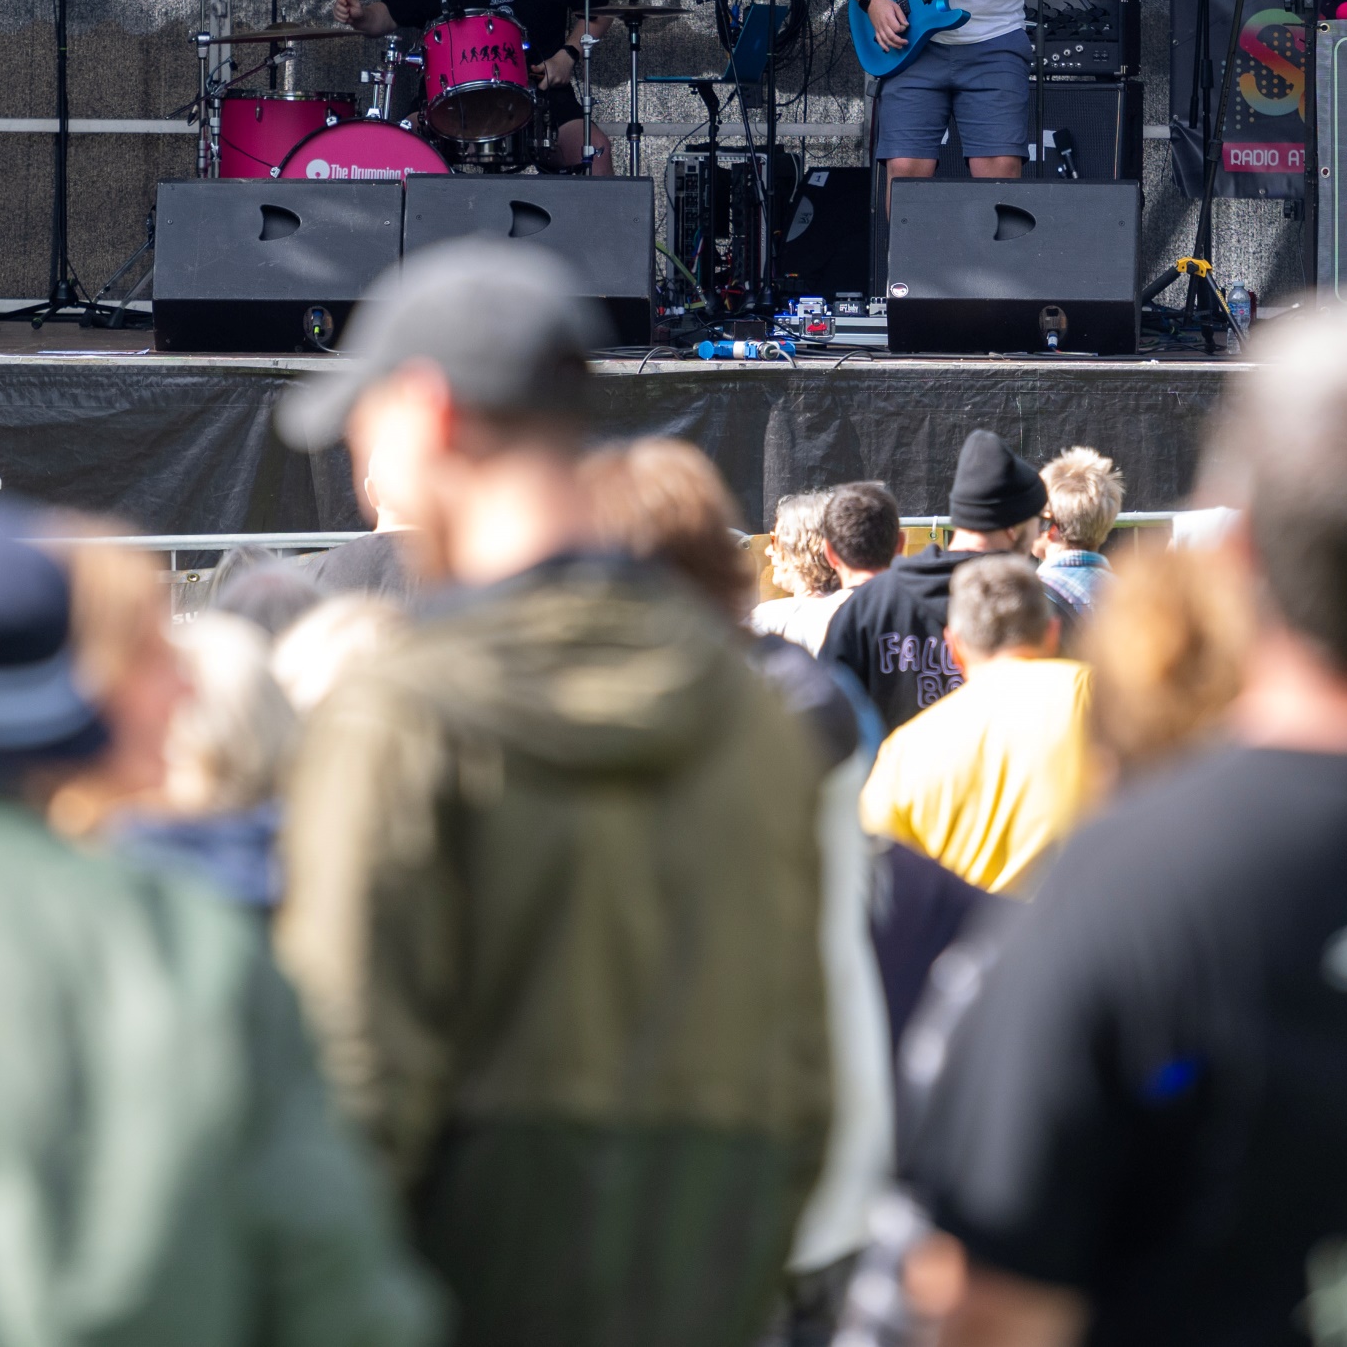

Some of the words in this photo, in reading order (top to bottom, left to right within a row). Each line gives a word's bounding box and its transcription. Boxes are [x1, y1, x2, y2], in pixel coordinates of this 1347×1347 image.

[1230, 149, 1280, 168] RADIO
[330, 164, 349, 180] The
[351, 165, 402, 180] Drumming
[878, 631, 963, 675] FALL
